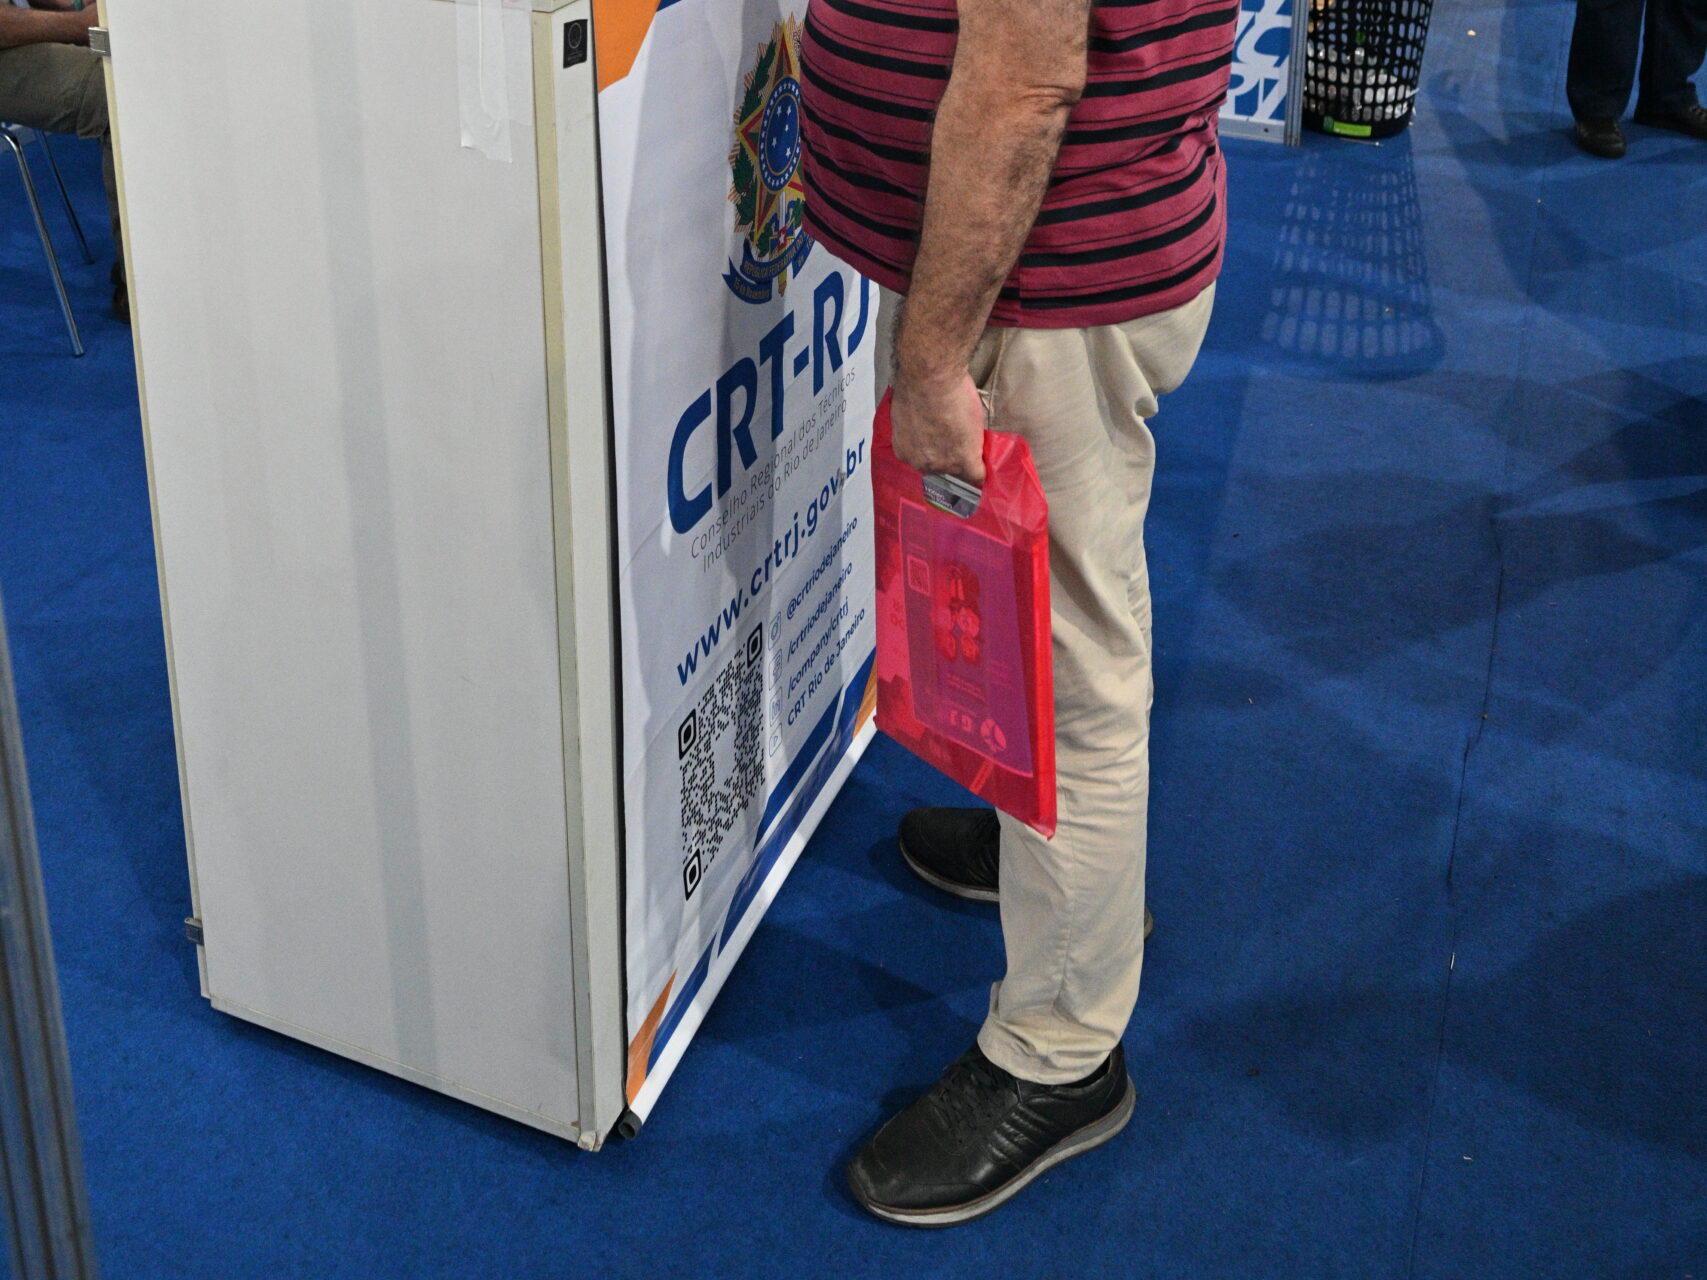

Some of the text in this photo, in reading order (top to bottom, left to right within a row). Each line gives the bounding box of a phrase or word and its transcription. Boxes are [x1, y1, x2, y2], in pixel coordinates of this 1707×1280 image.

[667, 271, 869, 534] CRT-RJ
[691, 367, 856, 559] Conselho Regional dos Técnicos
[703, 399, 847, 573] Industriais do Rio de Janeiro
[677, 438, 865, 686] www.crtrj.gov.br
[786, 517, 858, 620] @crtriodejaneiro
[787, 562, 853, 663] /crtriodejaneiro
[787, 597, 849, 699] /company/crtrj
[787, 607, 865, 727] CRT Rio de Janeiro
